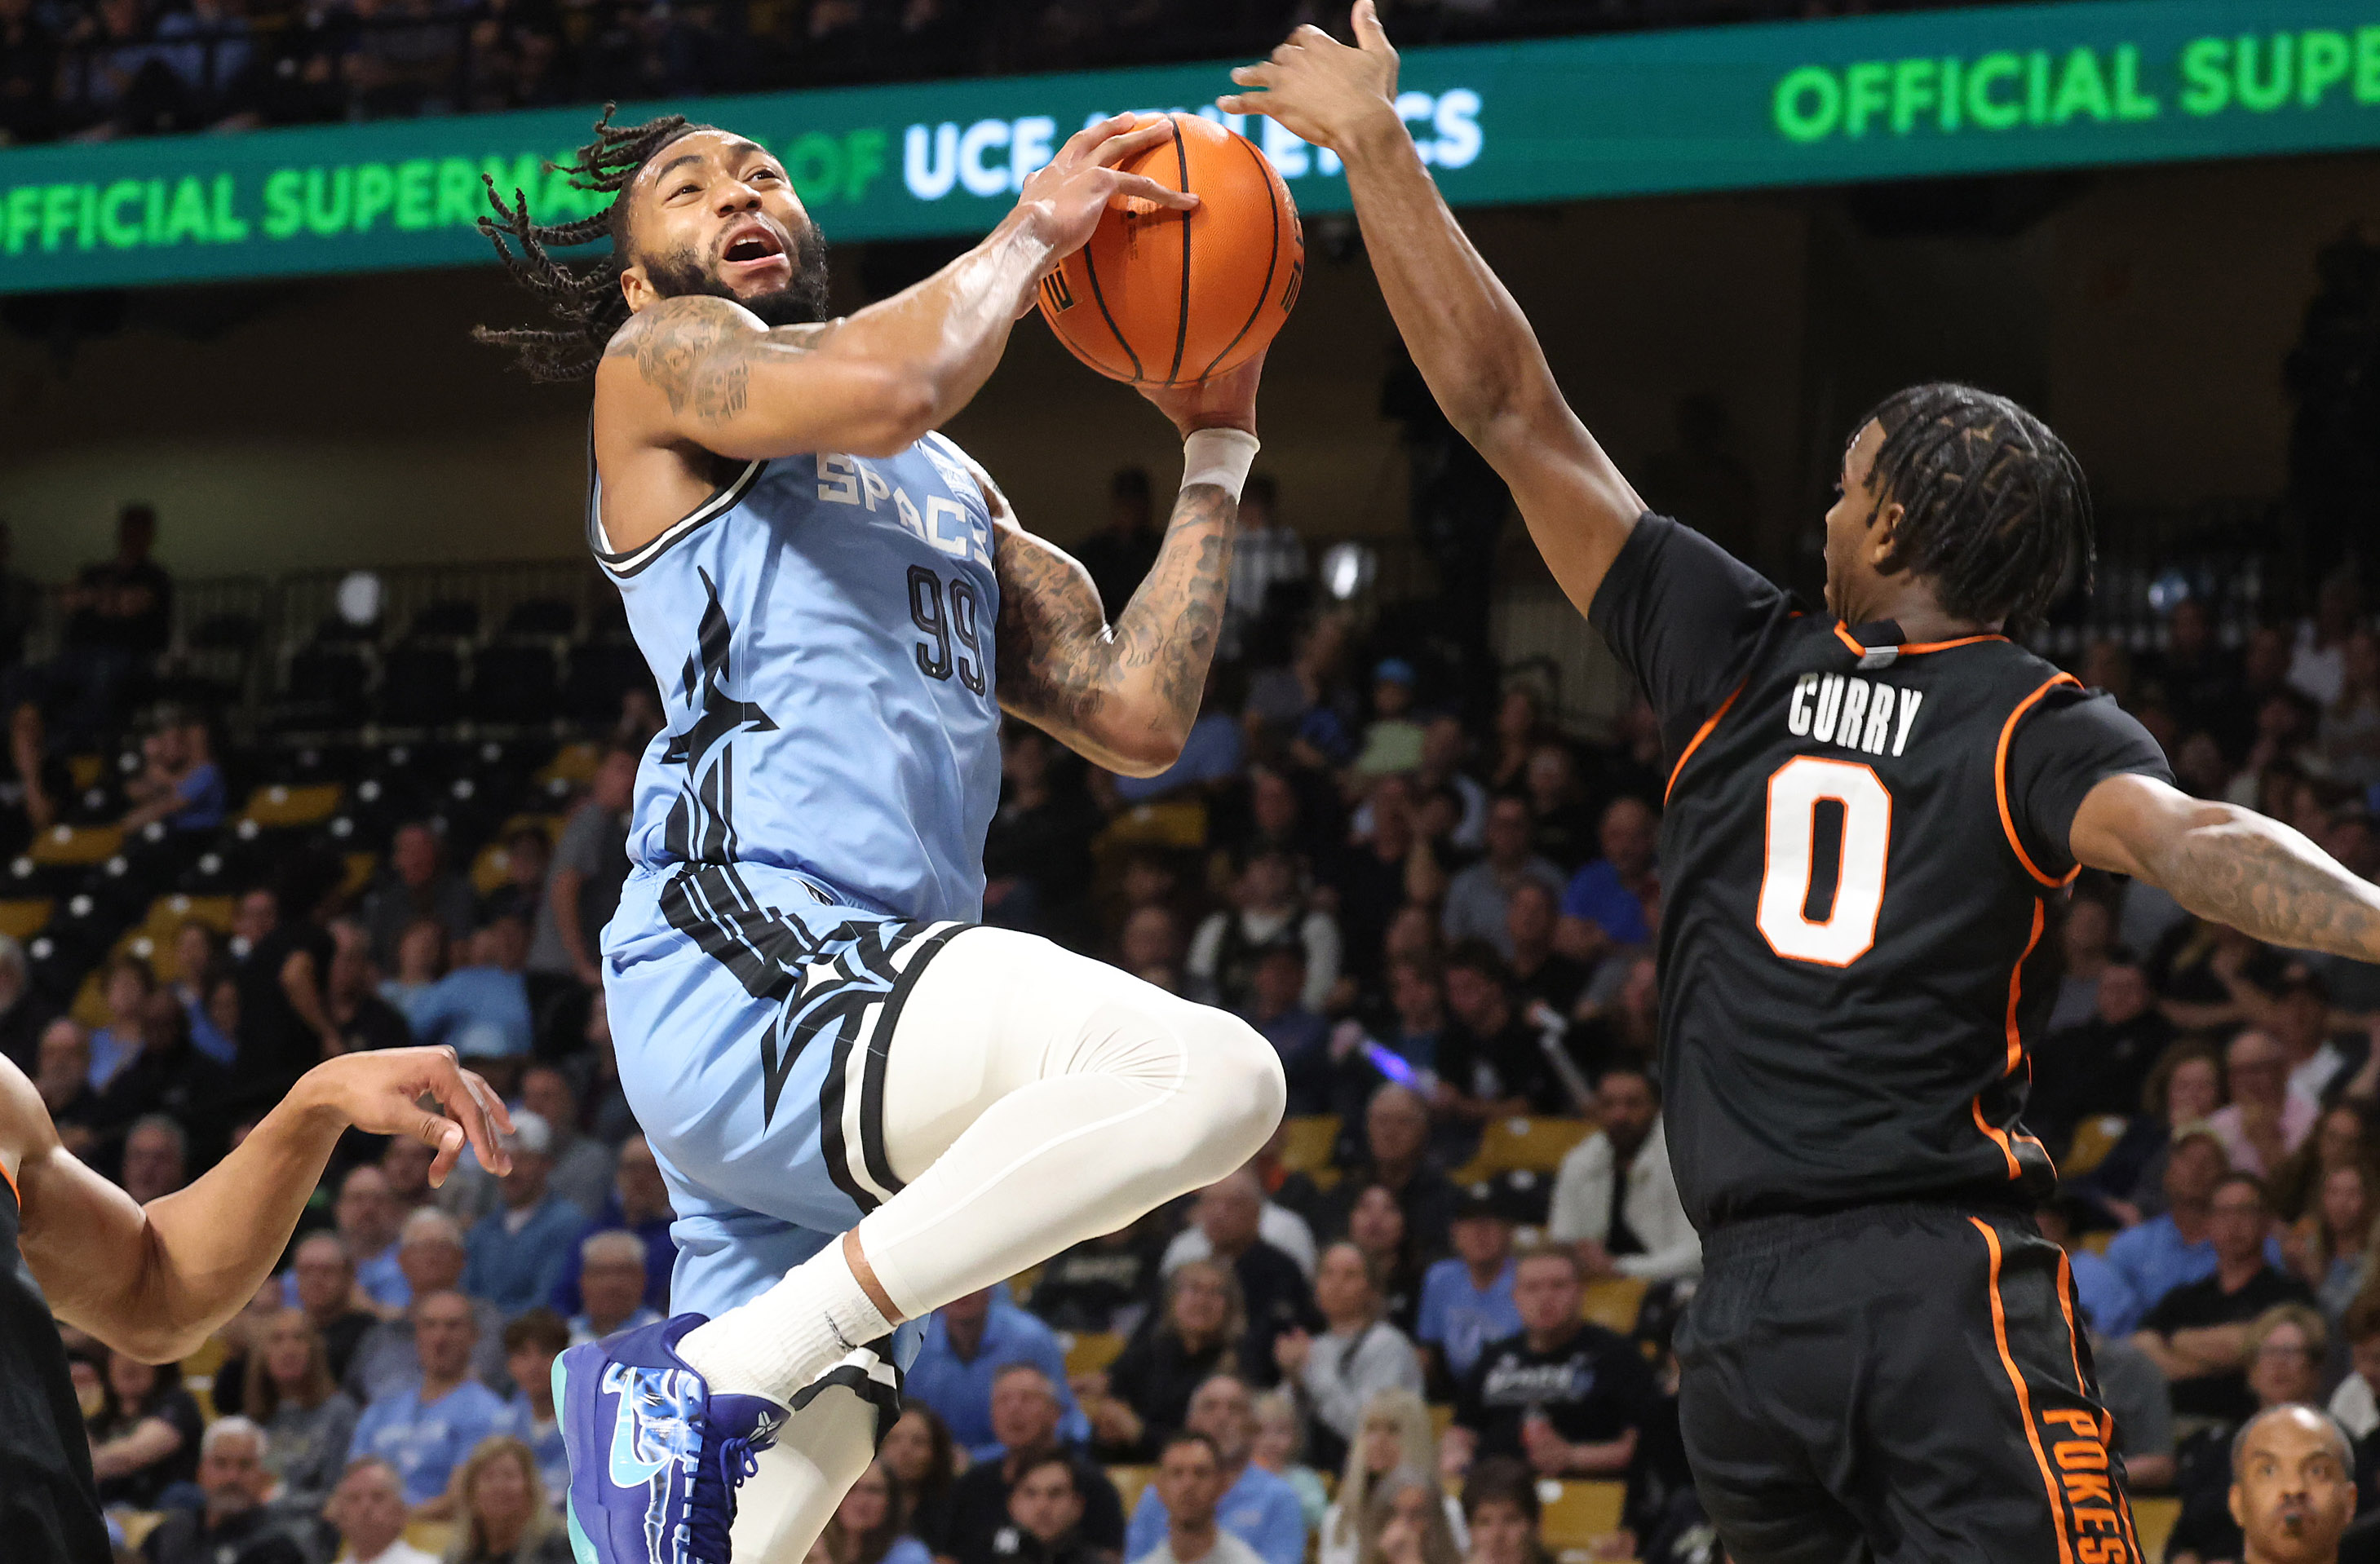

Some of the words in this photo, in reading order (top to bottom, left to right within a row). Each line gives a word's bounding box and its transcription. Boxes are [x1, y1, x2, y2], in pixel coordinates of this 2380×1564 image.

[1773, 42, 2159, 142] OFFICIAL
[0, 170, 248, 256] FFICIAL
[262, 147, 630, 239] SUPERMA
[785, 128, 889, 205] OF
[903, 116, 1056, 201] UCF
[907, 563, 986, 698] 99
[1788, 671, 1923, 757] CURRY
[1756, 753, 1892, 969] 0
[2042, 1408, 2128, 1564] POKES
